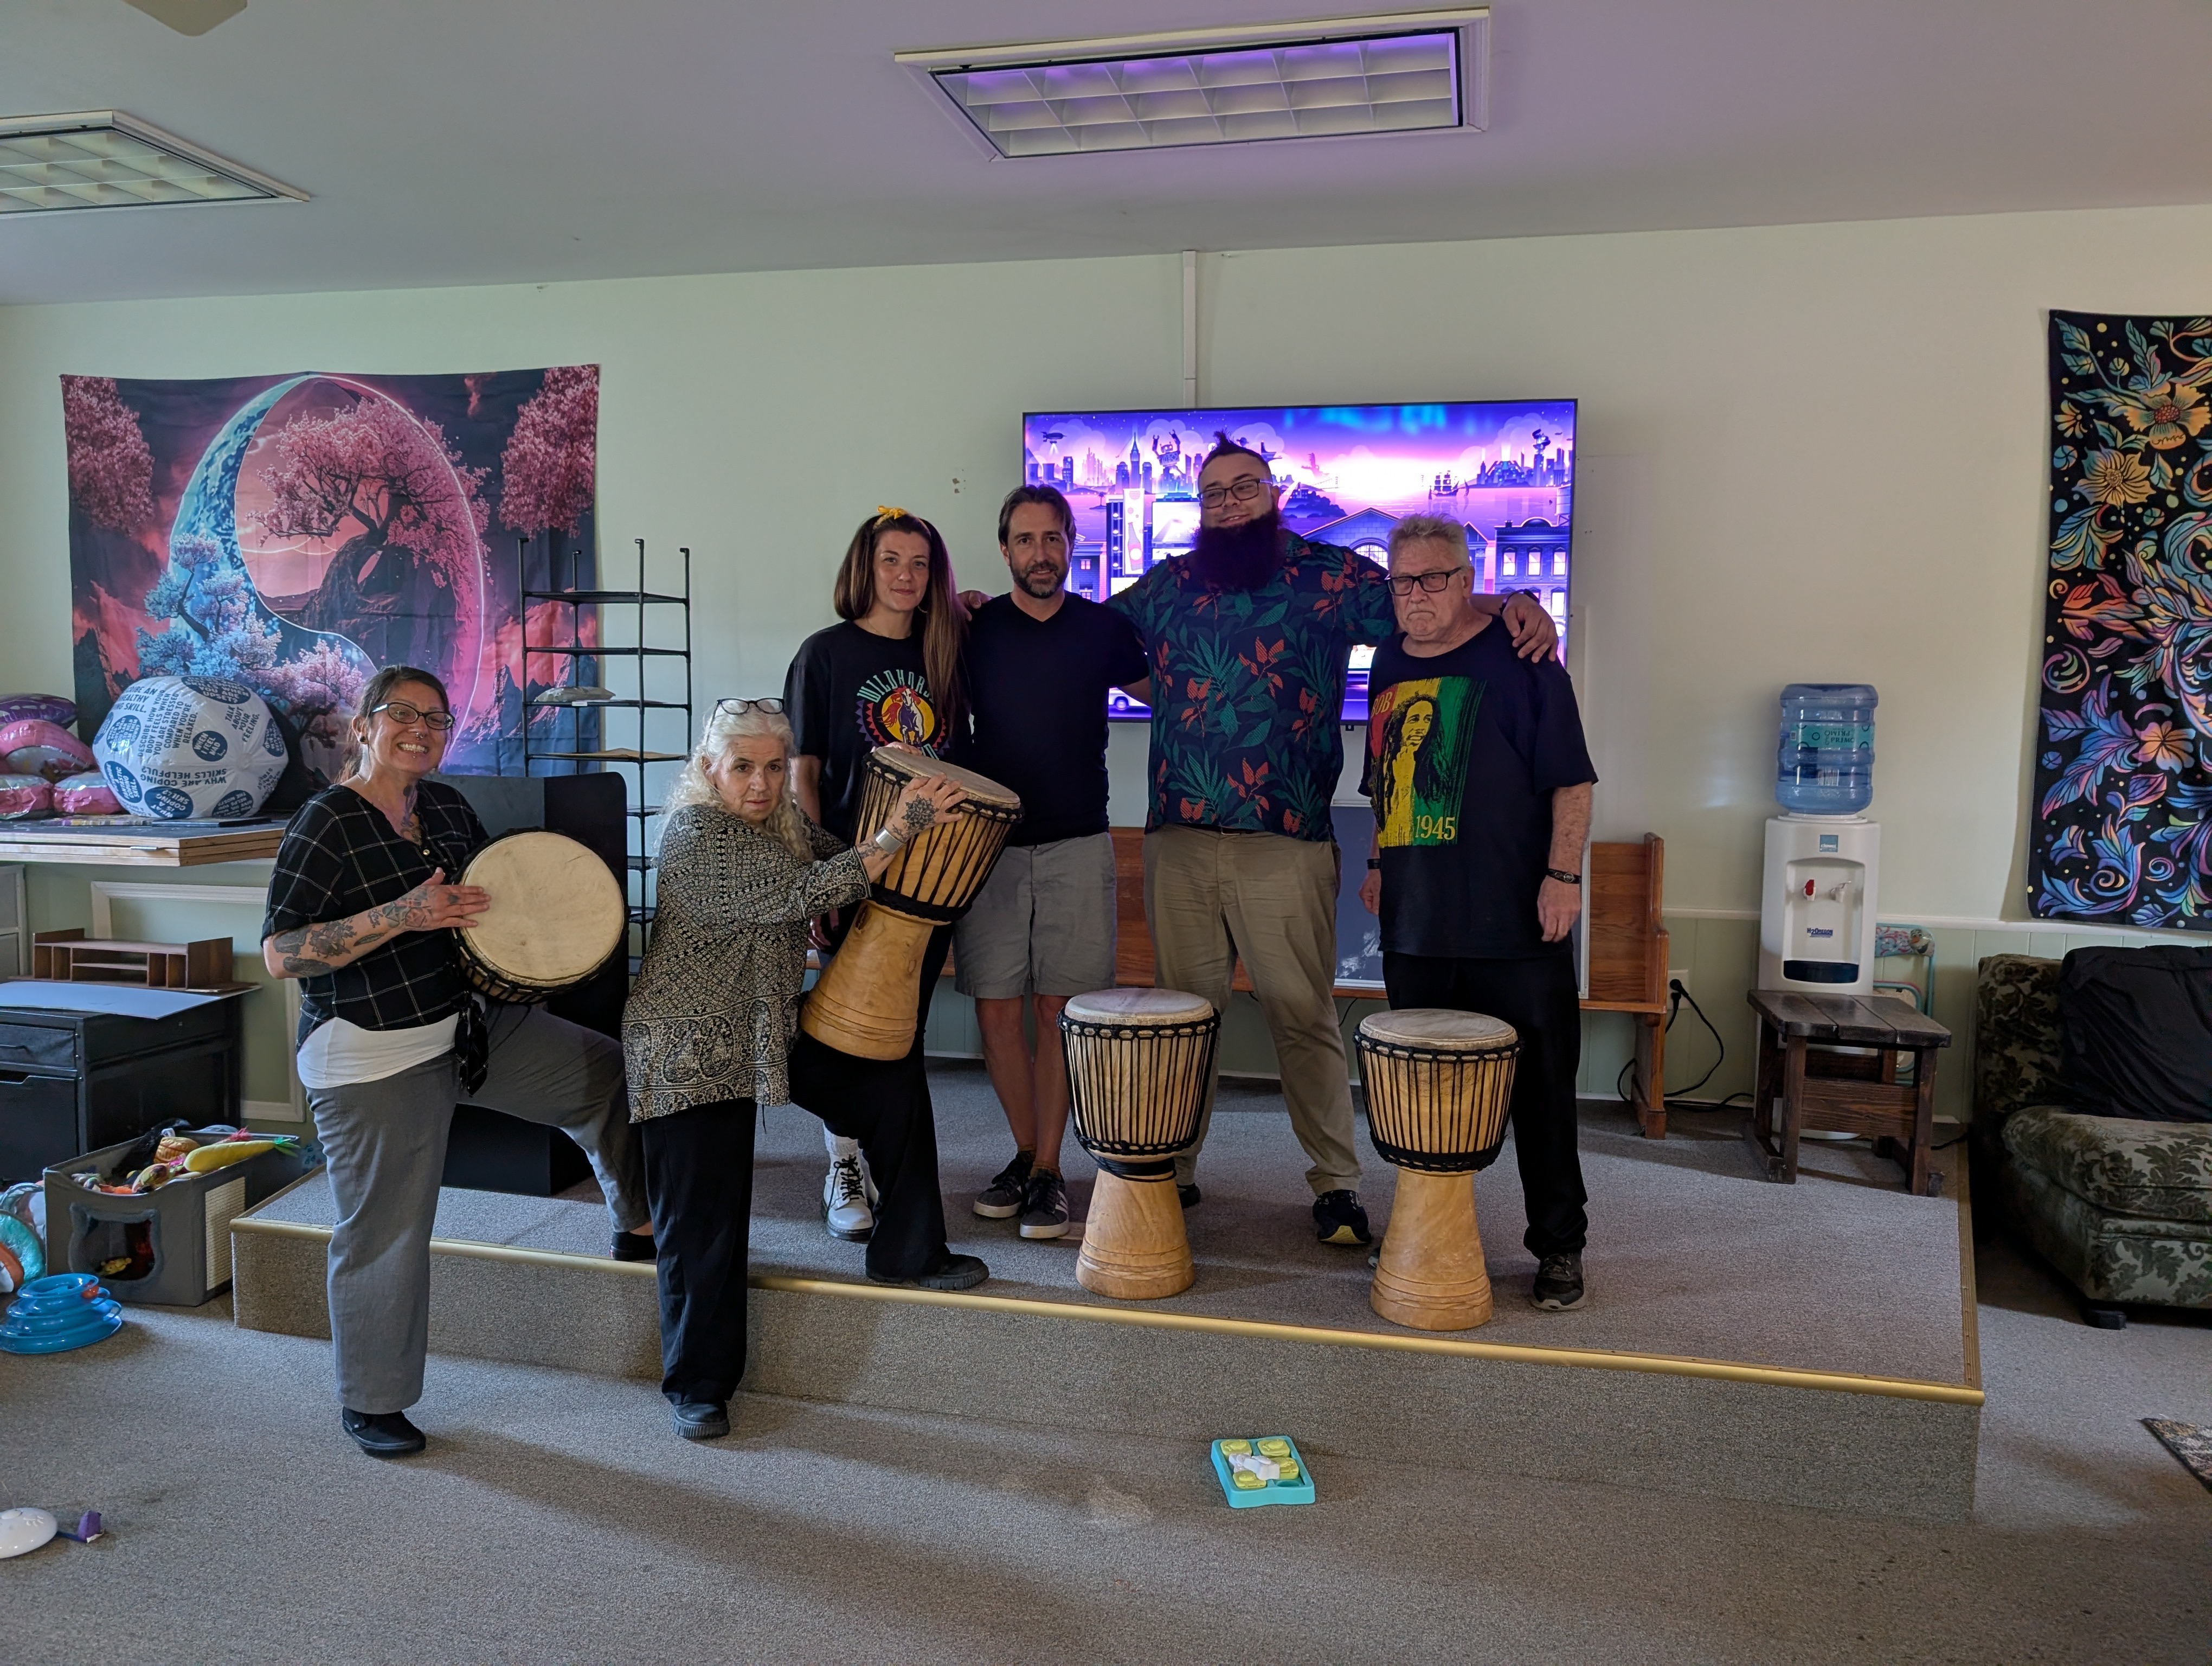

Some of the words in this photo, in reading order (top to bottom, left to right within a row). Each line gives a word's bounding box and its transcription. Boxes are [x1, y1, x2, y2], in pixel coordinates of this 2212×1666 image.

[185, 681, 218, 689] SKILLS
[221, 686, 249, 697] WHEN
[203, 691, 238, 703] UPSET?
[222, 690, 240, 699] ARE
[124, 702, 147, 713] SKILL.
[162, 693, 179, 724] STRESSED
[1371, 691, 1393, 718] BOB
[225, 705, 235, 722] TALK
[232, 707, 243, 730] ABOUT
[238, 713, 251, 731] YOUR
[138, 725, 151, 758] DESCRIBE
[147, 707, 157, 722] HOW
[153, 690, 165, 705] YOUR
[145, 735, 156, 753] BODY
[151, 714, 163, 733] FEELS
[158, 693, 171, 712] WHEN
[164, 712, 180, 749] COMPARED
[175, 701, 184, 709] TO
[172, 728, 184, 748] WHEN
[178, 703, 192, 726] YOU'RE
[182, 712, 198, 744] RELAXED.
[242, 714, 260, 742] FEELING.
[158, 726, 167, 739] ARE
[153, 741, 163, 755] YOU
[194, 733, 209, 750] WHEN
[203, 736, 216, 750] FEEL
[209, 741, 221, 756] MAD
[140, 774, 177, 787] COPING
[142, 766, 191, 779] HELPFUL?
[195, 768, 227, 779] SKILLS
[205, 776, 227, 784] WHY
[115, 766, 130, 799] FANTASTIC
[123, 775, 134, 798] COPING
[130, 779, 140, 798] SKILL.
[156, 793, 186, 811] COPING
[162, 790, 189, 805] SKILL?
[151, 804, 173, 818] WHAT
[1415, 815, 1456, 840] 1945
